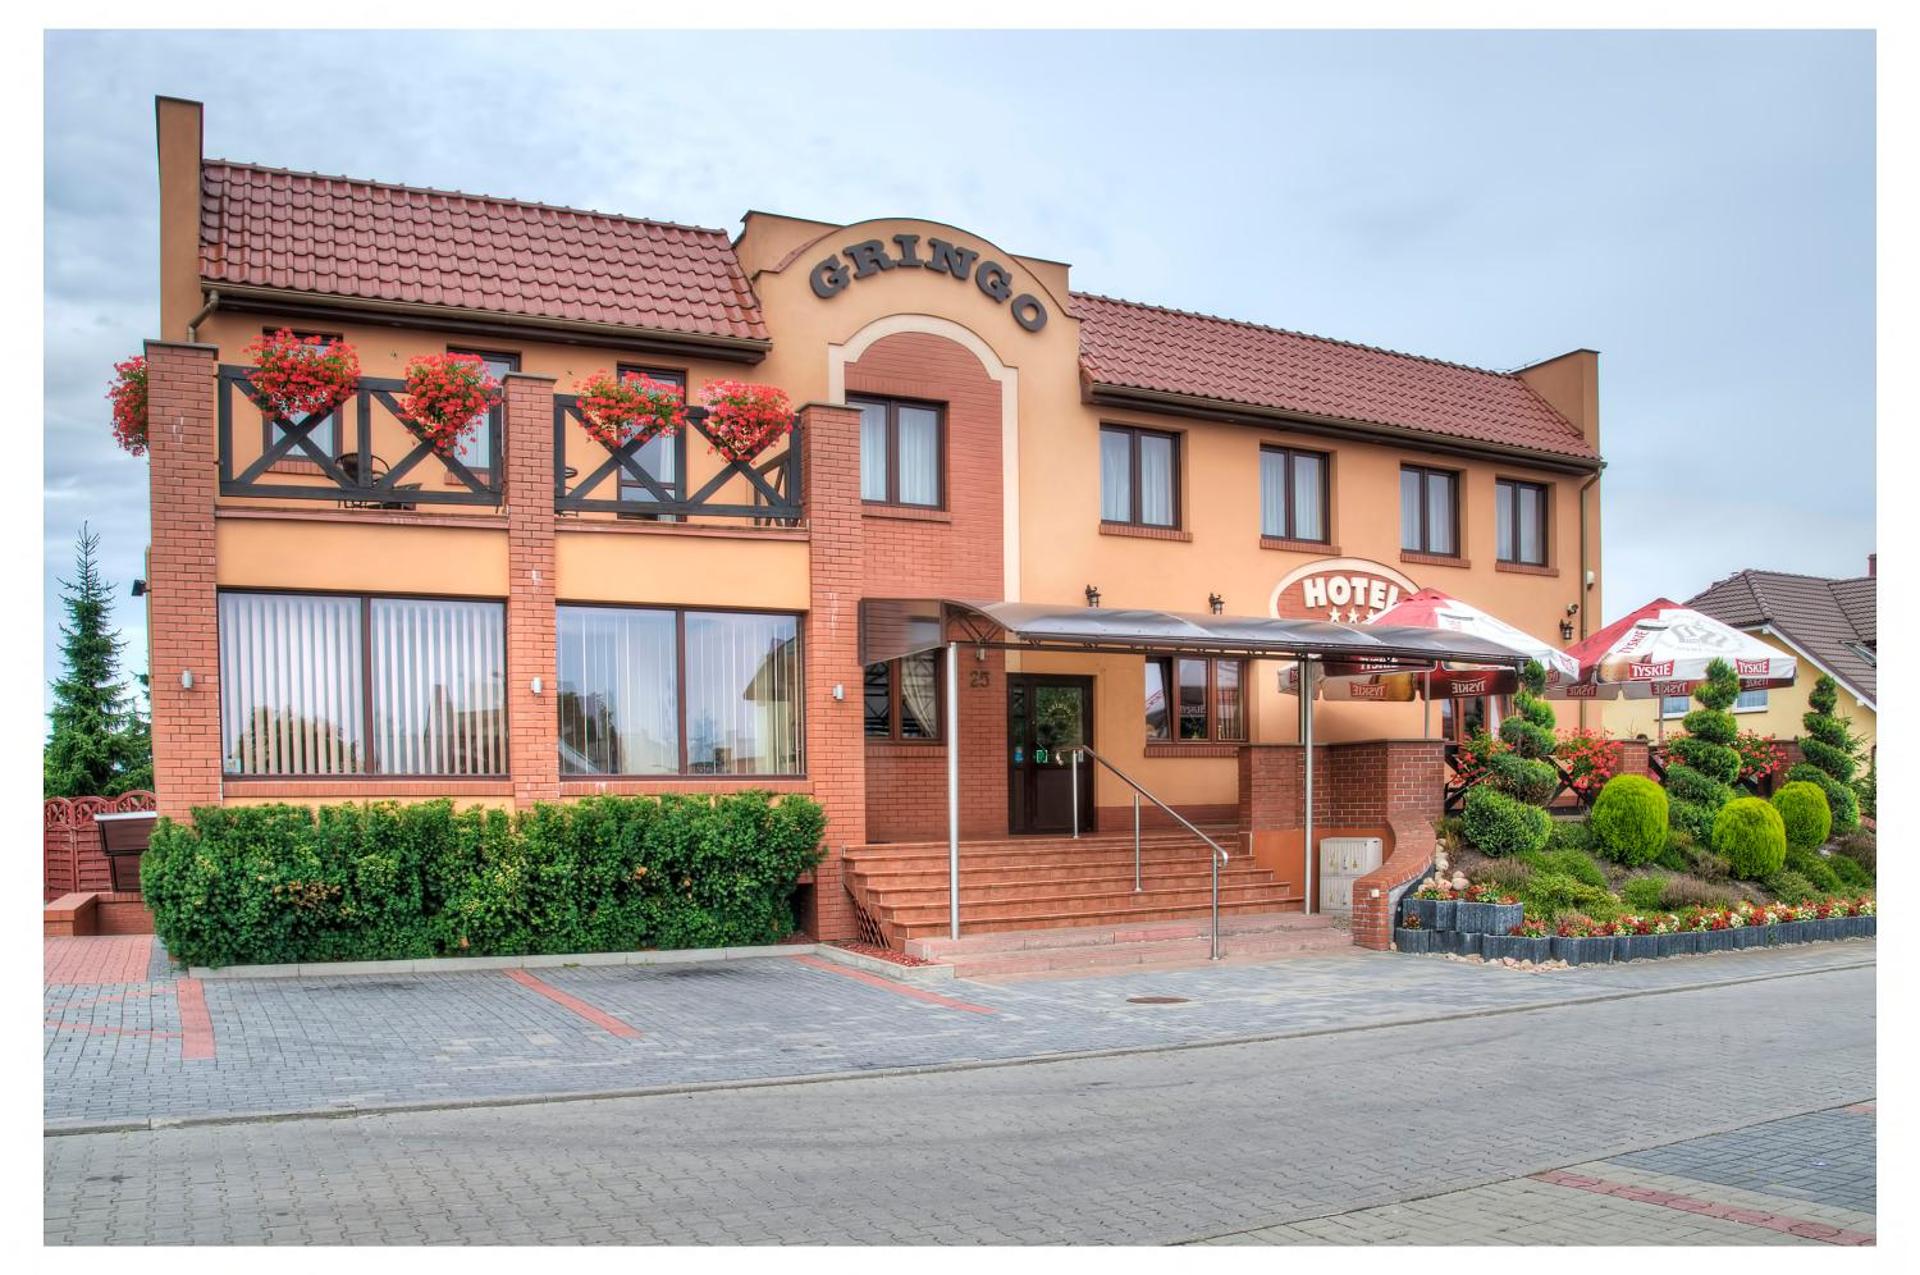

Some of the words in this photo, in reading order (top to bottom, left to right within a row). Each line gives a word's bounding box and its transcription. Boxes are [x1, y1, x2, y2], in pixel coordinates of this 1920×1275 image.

[809, 234, 1048, 333] GRINGO
[1303, 576, 1399, 609] HOTEL
[1631, 663, 1671, 677] TYSKIE
[1738, 661, 1768, 674] TYSKIE
[969, 670, 990, 688] 25
